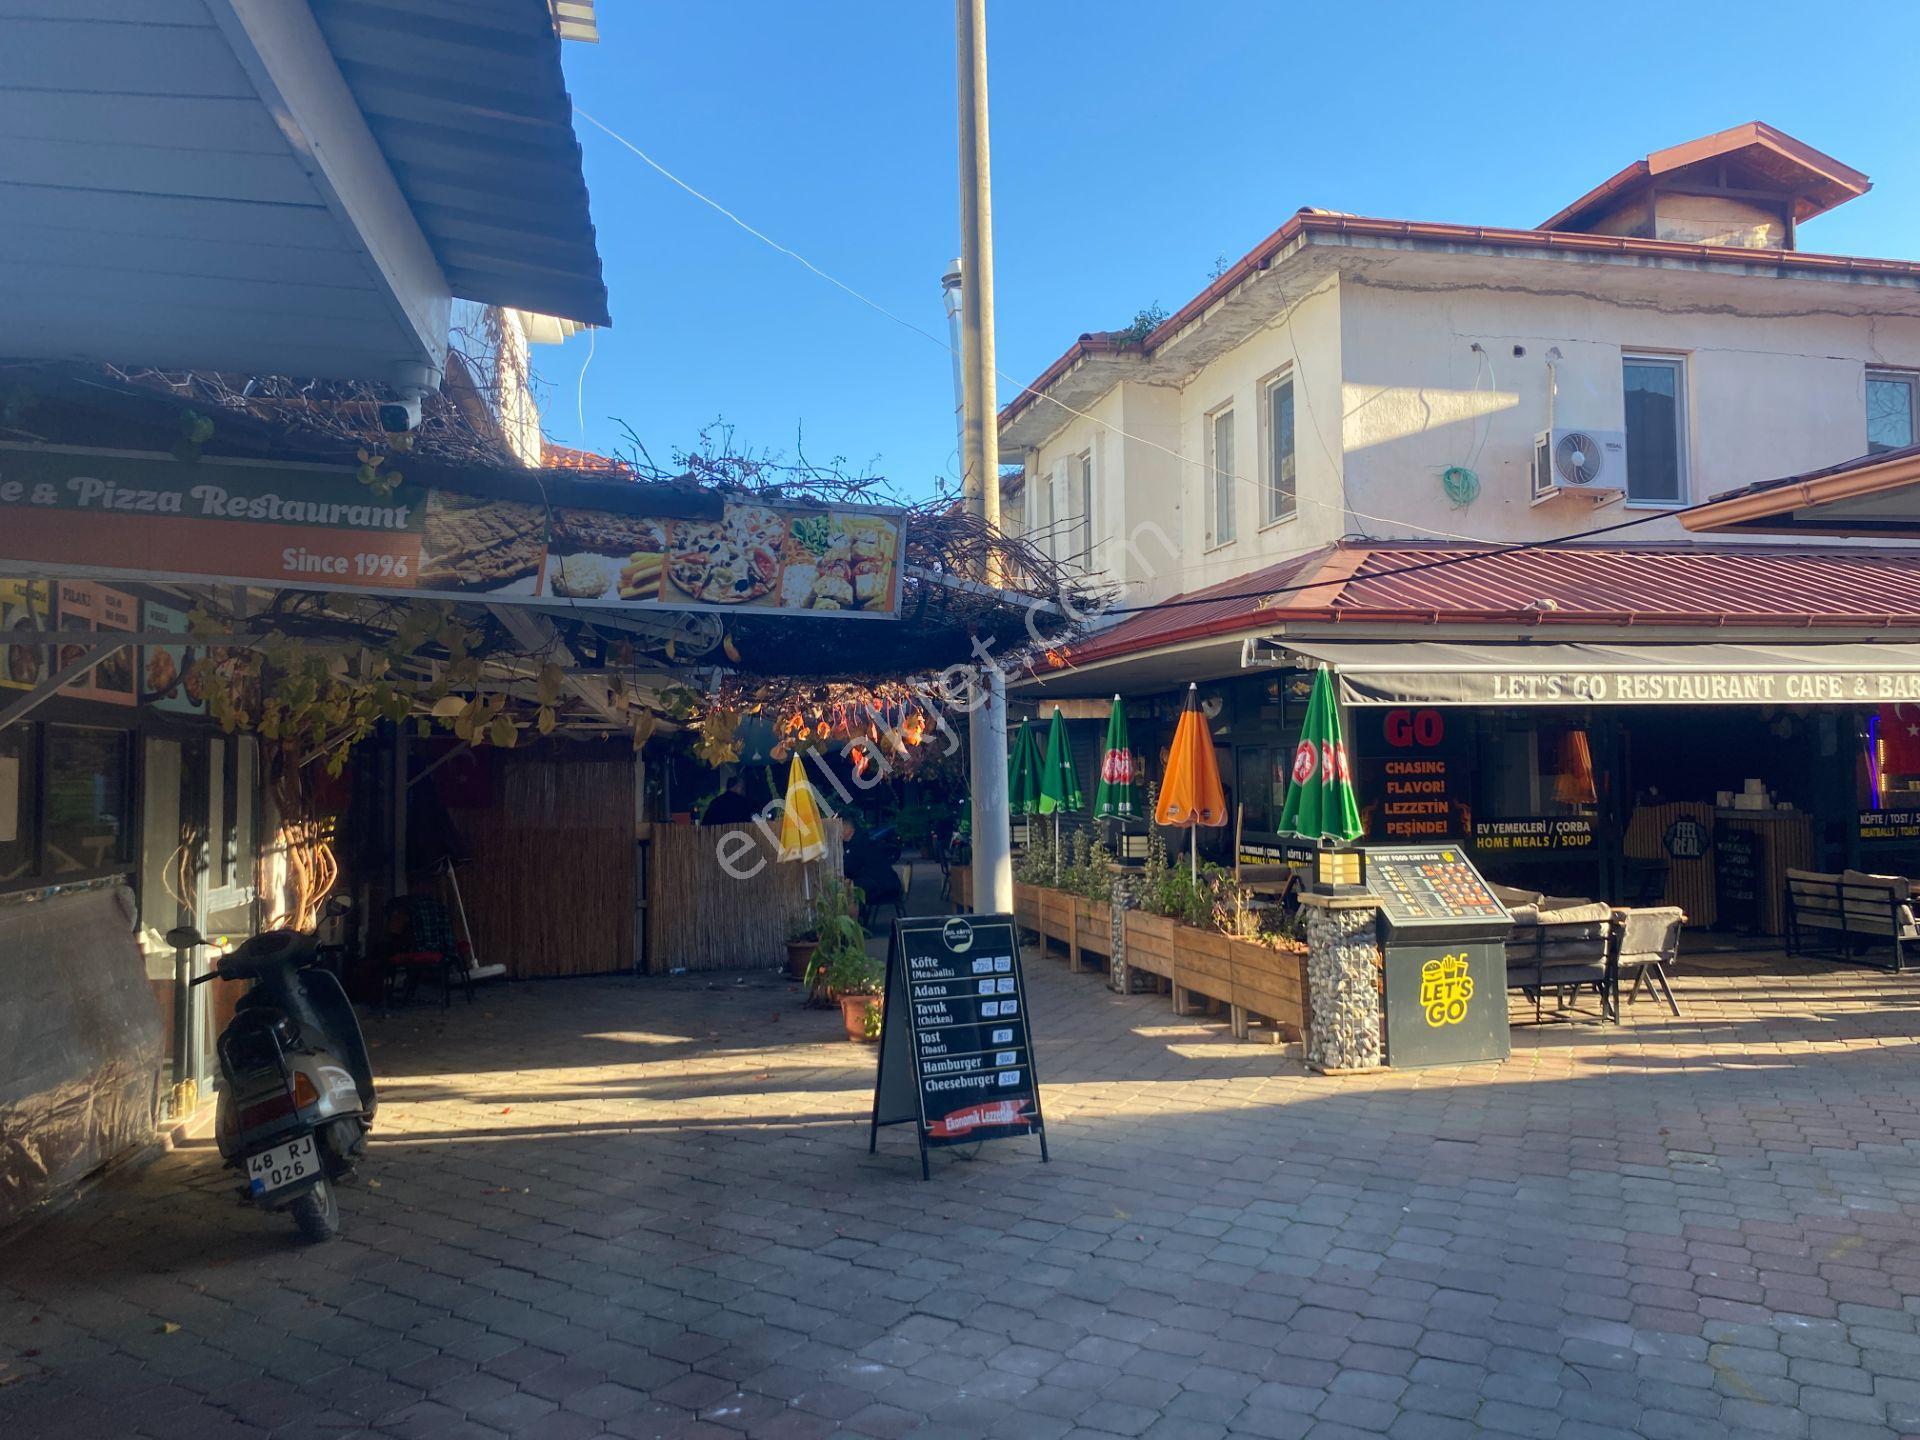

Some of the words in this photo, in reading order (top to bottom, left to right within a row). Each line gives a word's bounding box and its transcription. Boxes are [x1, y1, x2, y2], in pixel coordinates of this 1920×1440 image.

[30, 483, 58, 505] &
[66, 476, 183, 513] Pizza
[190, 484, 411, 530] Restaurant
[282, 547, 349, 575] Since
[354, 552, 408, 578] 1996
[1493, 674, 1561, 699] LET'S
[1574, 674, 1607, 699] GO
[1617, 675, 1775, 699] RESTAURANT
[1785, 674, 1844, 698] CAFE
[1854, 677, 1869, 696] &
[1878, 676, 1920, 698] BAR
[1383, 709, 1444, 747] GO
[1384, 761, 1446, 774] CHASING
[1386, 780, 1445, 794] FLAVOR!
[1384, 798, 1449, 815] LEZZETİN
[1890, 813, 1909, 823] TOST
[1386, 819, 1448, 837] PEŞİNDE!
[1476, 823, 1490, 834] EV
[1491, 820, 1546, 834] YEMEKLERİ
[1556, 821, 1591, 836] ÇORBA
[1676, 822, 1697, 837] FEEL
[1476, 836, 1509, 848] HOME
[1512, 836, 1550, 847] MEALS
[1562, 834, 1592, 846] SOUP
[1673, 838, 1700, 855] REAL
[910, 956, 938, 969] Köfte
[912, 967, 955, 979] (Meaballs)
[914, 984, 947, 997] Adana
[1422, 977, 1472, 1002] LET'S
[916, 1001, 947, 1015] Tavuk
[1428, 998, 1465, 1023] GO
[918, 1015, 953, 1026] (Chicken)
[919, 1031, 940, 1044] Tost
[921, 1044, 947, 1056] (Toast)
[923, 1057, 982, 1074] Hamburger
[925, 1074, 995, 1092] Cheeseburger
[946, 1110, 981, 1131] Ekonomik
[252, 1153, 274, 1172] 48
[288, 1138, 311, 1160] RJ
[271, 1160, 305, 1185] 026
